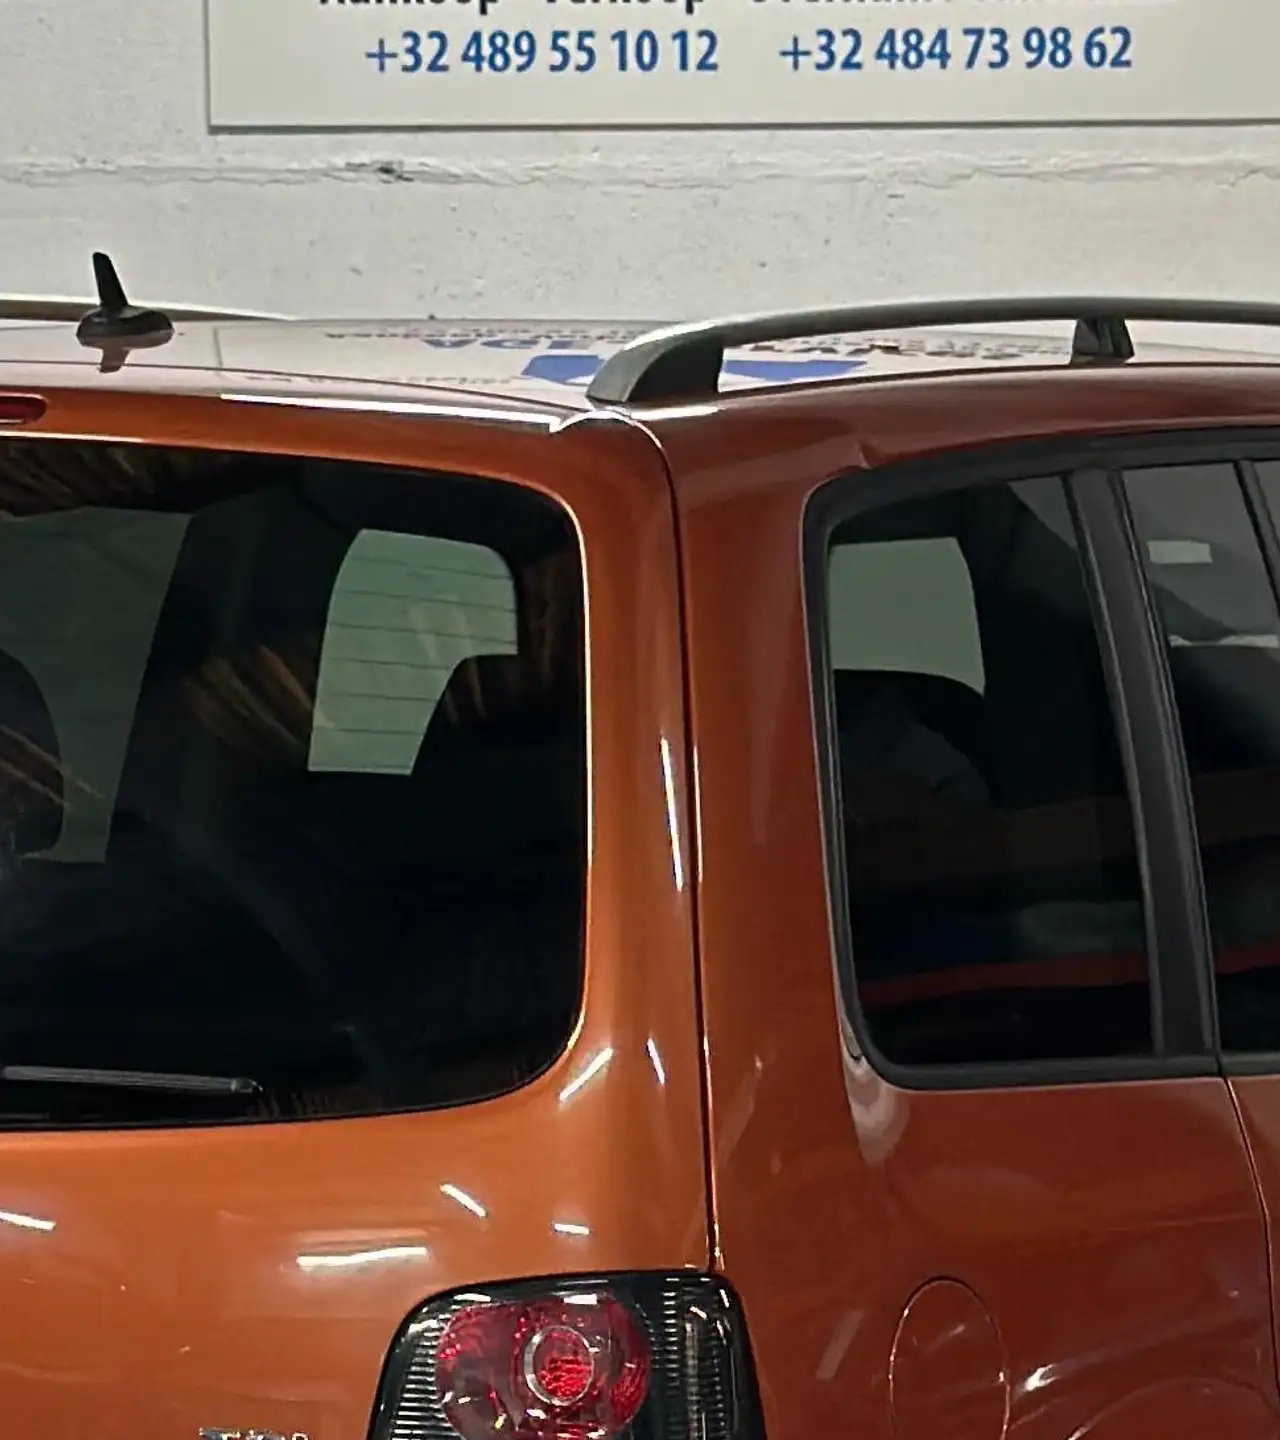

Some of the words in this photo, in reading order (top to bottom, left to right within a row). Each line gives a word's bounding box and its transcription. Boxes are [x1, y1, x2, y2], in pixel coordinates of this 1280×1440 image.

[365, 29, 450, 73] +32
[461, 29, 537, 73] 489
[548, 29, 597, 73] 55
[609, 29, 659, 73] 10
[670, 28, 719, 73] 12
[779, 27, 863, 71] +32
[874, 27, 951, 70] 484
[962, 27, 1010, 70] 73
[1022, 26, 1073, 69] 98
[1083, 26, 1132, 69] 62
